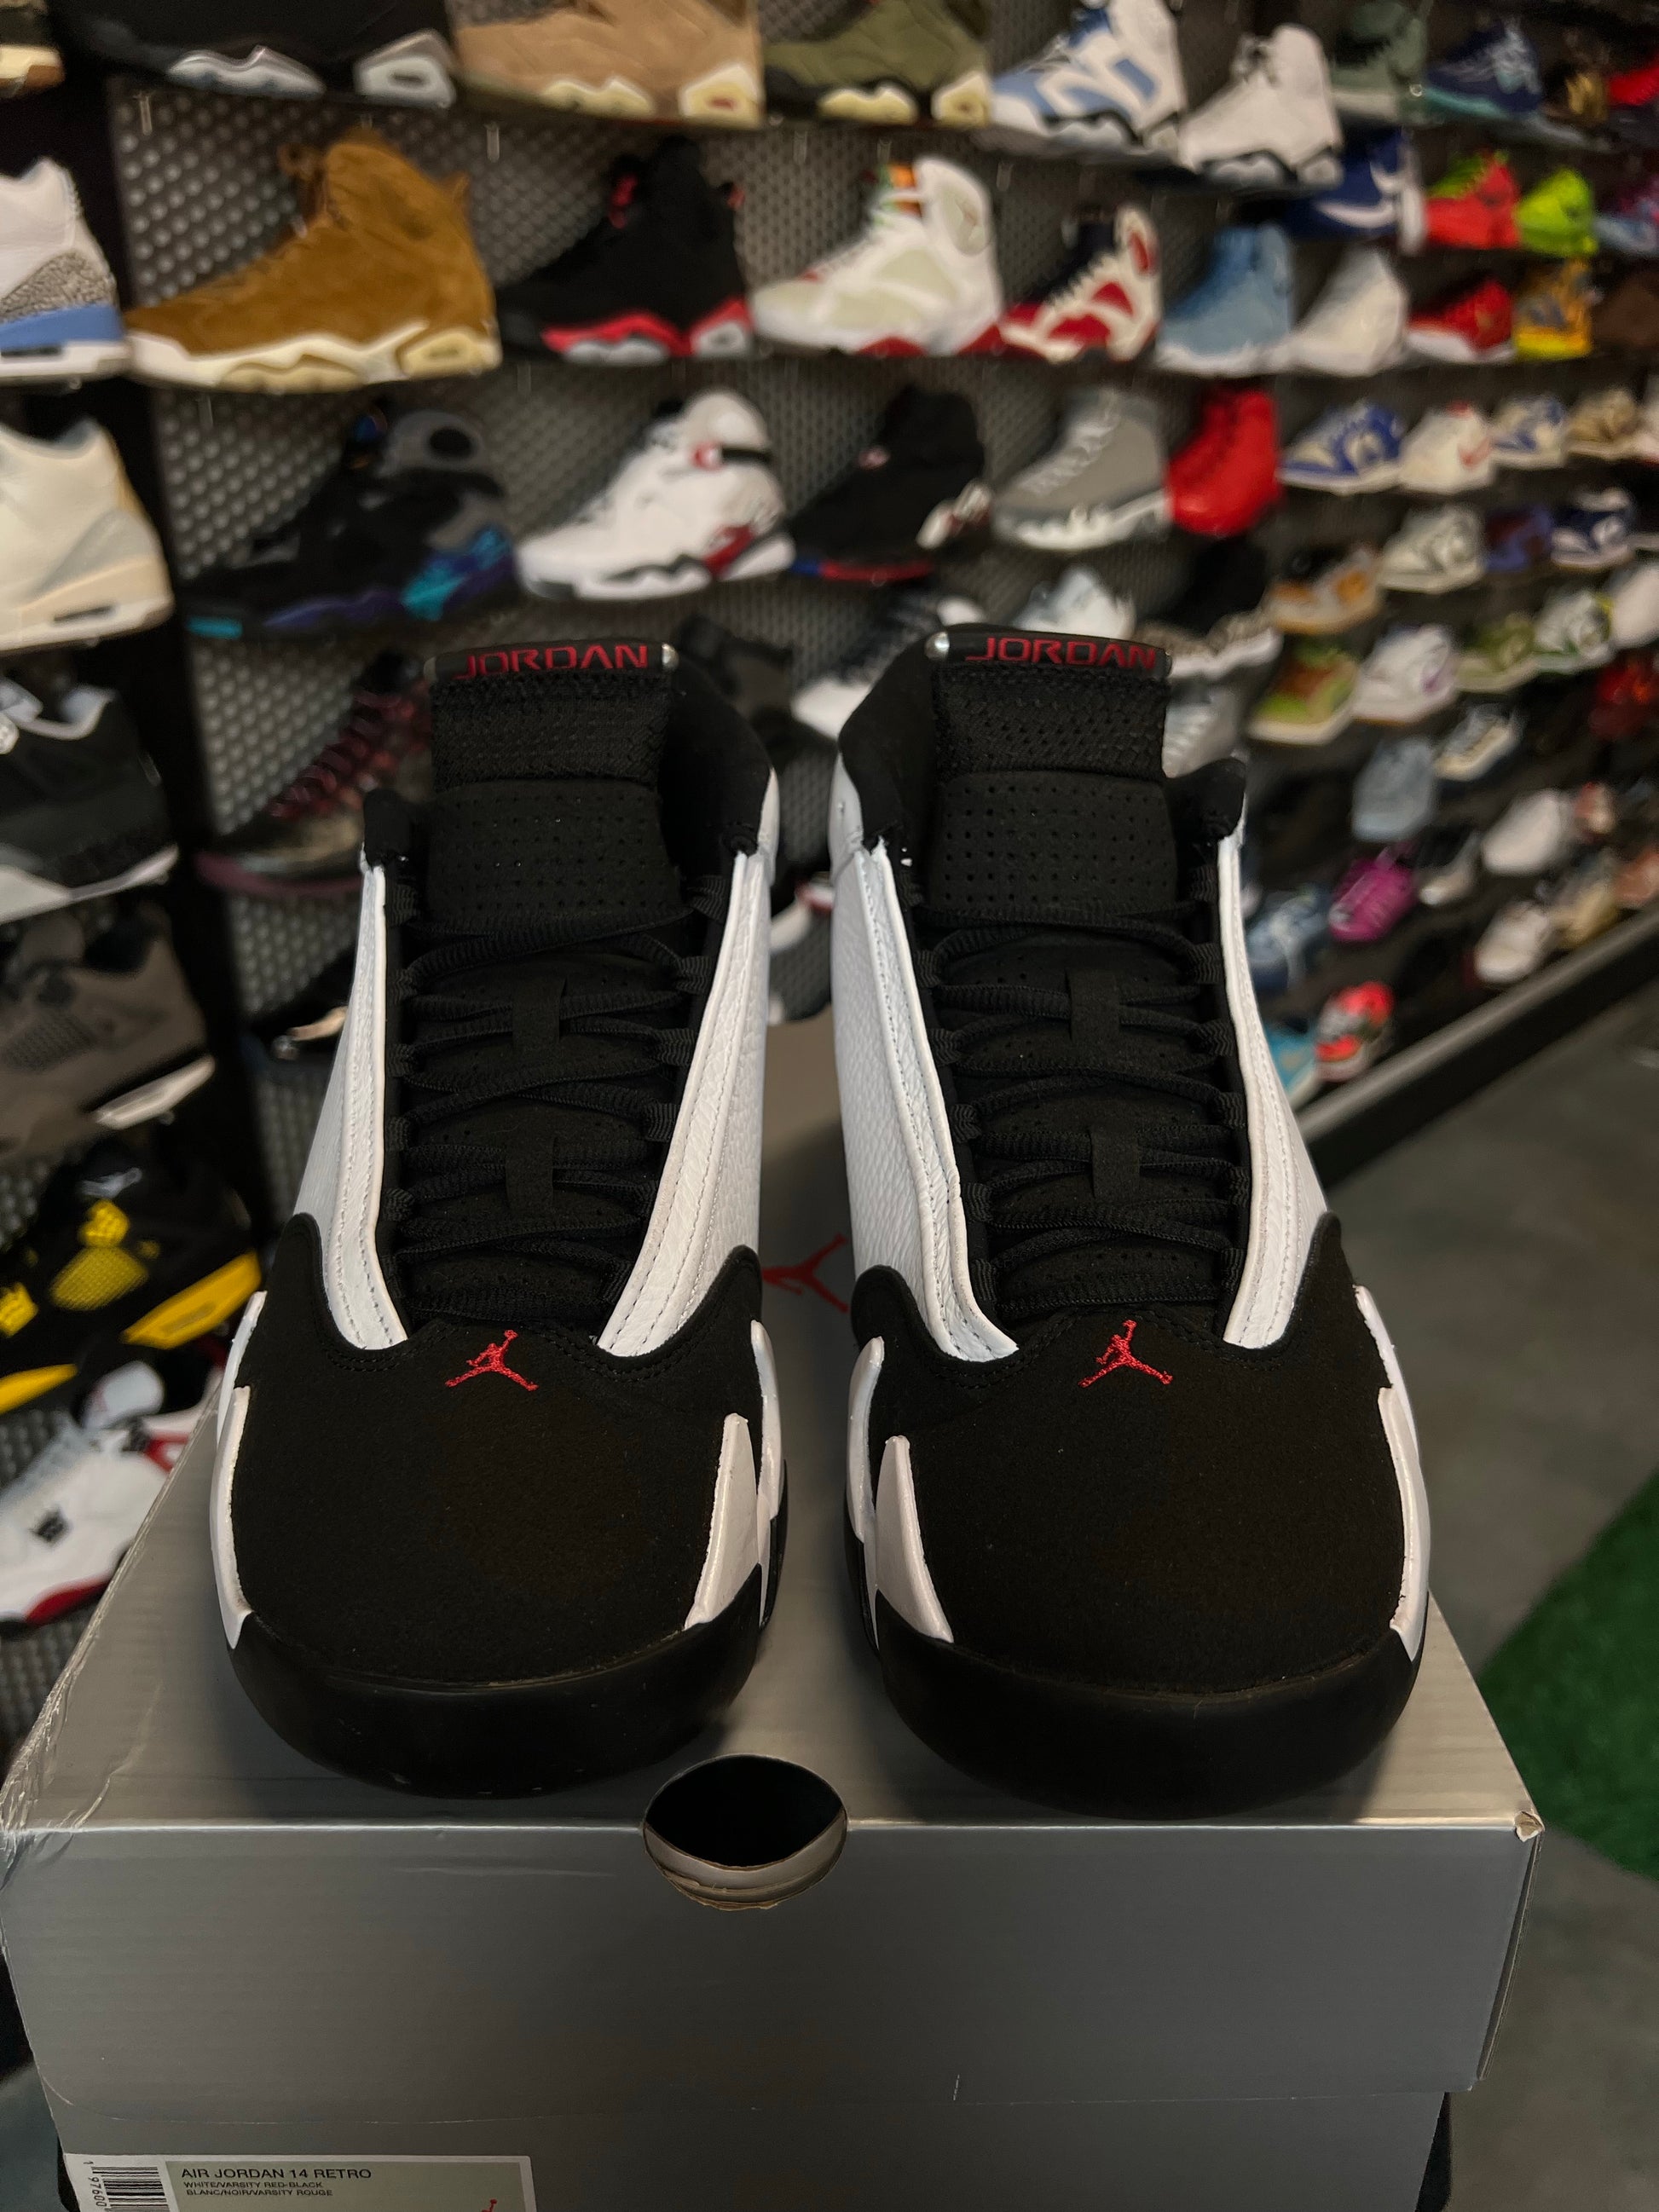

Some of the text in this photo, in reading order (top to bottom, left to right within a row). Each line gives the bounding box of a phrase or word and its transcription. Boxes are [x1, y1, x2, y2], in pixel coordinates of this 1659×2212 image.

[453, 644, 649, 680] JORDAN
[965, 637, 1156, 670] JORDAN
[182, 2169, 372, 2179] AIR JORDAN 14 RETRO
